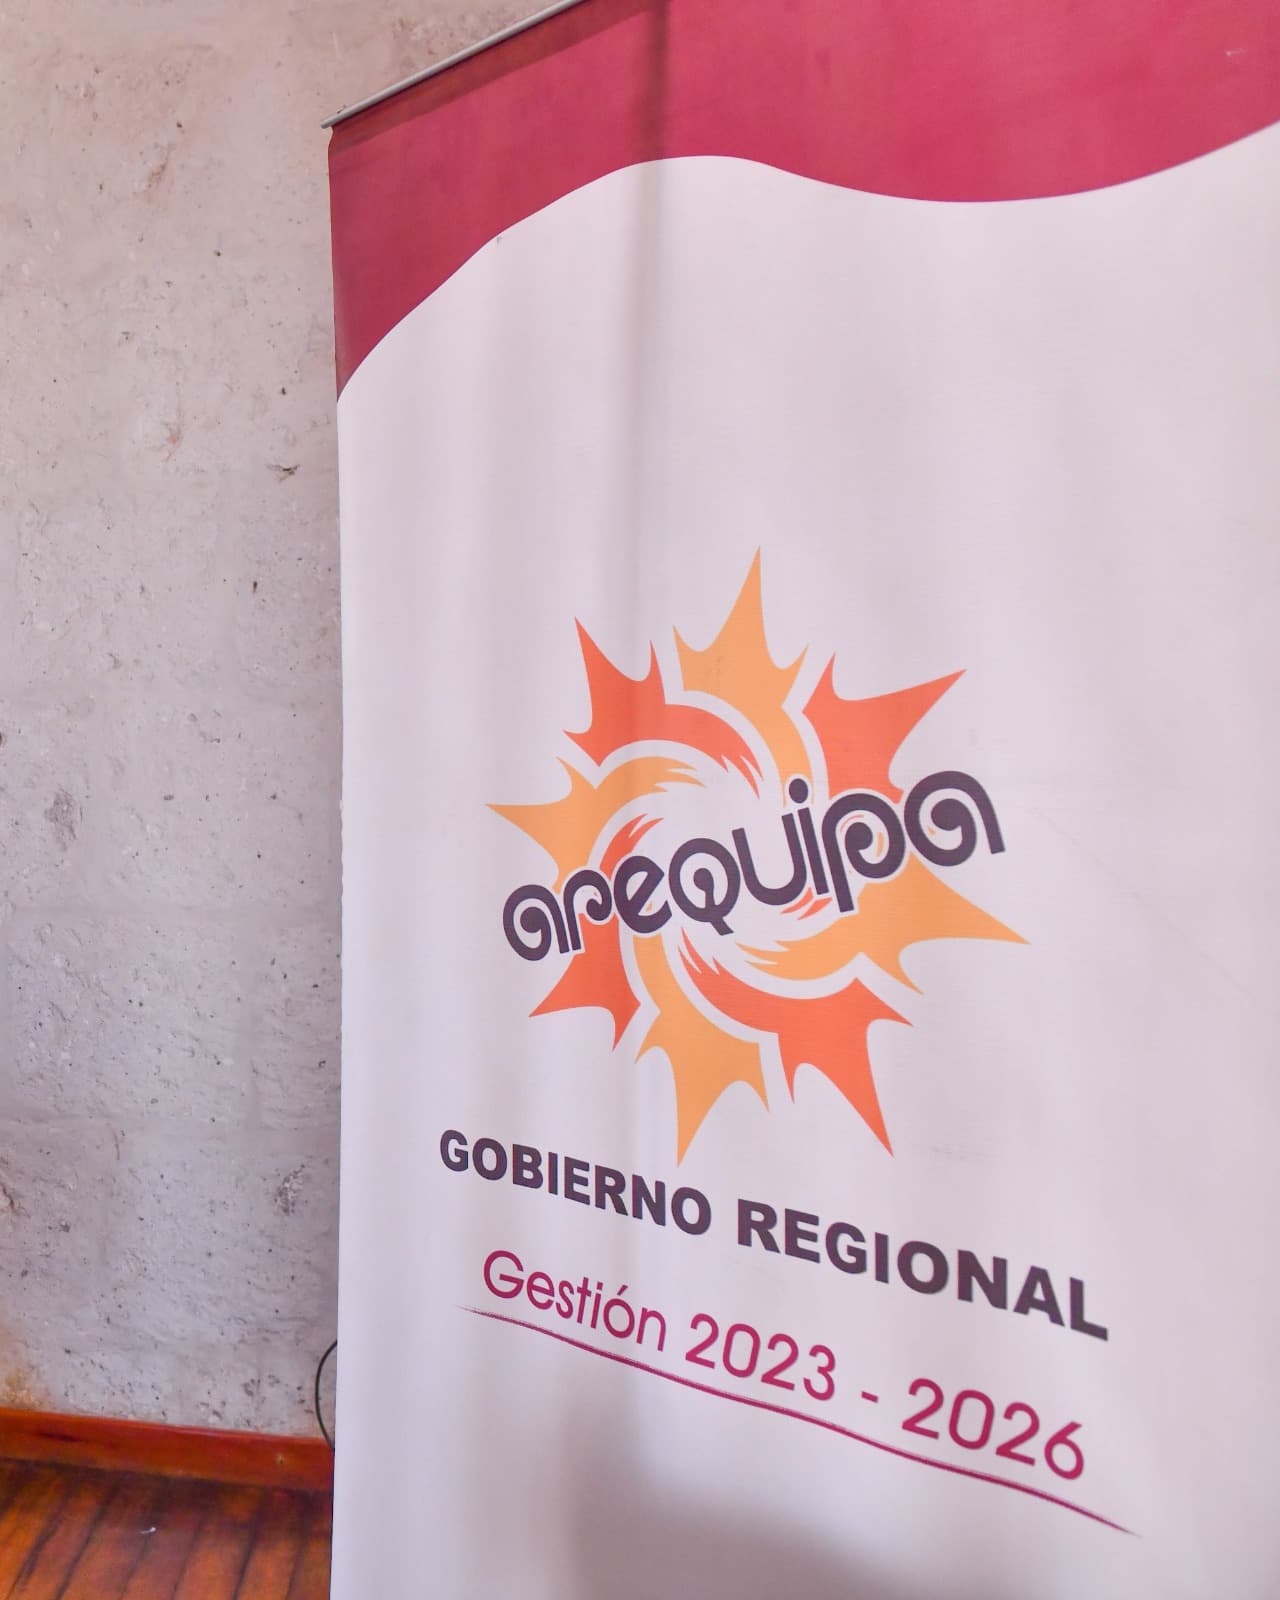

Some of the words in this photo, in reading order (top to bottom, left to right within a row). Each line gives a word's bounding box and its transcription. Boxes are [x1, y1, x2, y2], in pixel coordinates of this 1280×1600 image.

[439, 1129, 712, 1236] GOBIERNO
[737, 1198, 1109, 1341] REGIONAL
[483, 1249, 666, 1351] Gestión
[685, 1313, 836, 1402] 2023
[902, 1378, 1086, 1481] 2026
